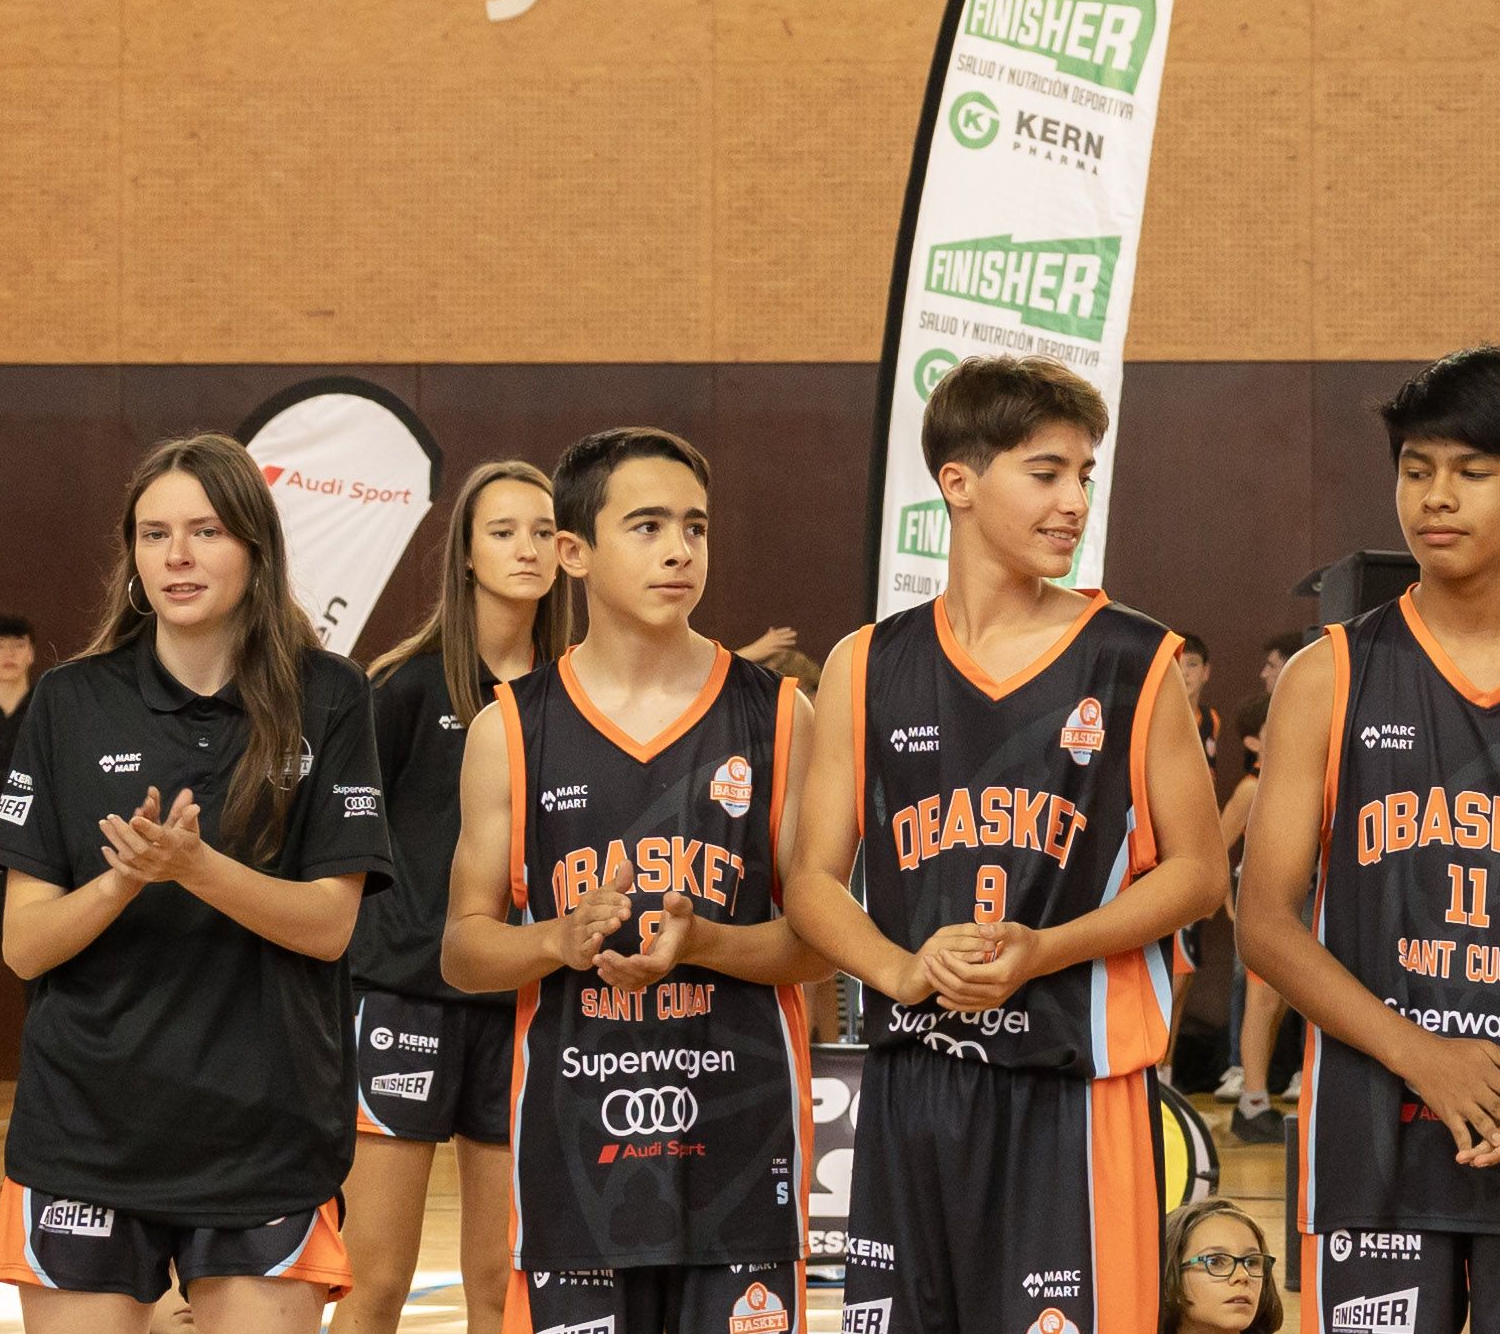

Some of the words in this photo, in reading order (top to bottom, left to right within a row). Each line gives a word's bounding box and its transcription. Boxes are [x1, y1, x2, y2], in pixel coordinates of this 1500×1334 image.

[957, 53, 997, 79] SALUD
[998, 64, 1006, 82] Y
[1071, 86, 1134, 120] DEPORTIVA
[1015, 109, 1104, 160] KERN
[1012, 141, 1099, 176] PHARMA
[930, 250, 1102, 319] FINISHER
[919, 310, 959, 336] SALUD
[961, 320, 970, 338] Y
[1036, 337, 1100, 368] DEPORTIVA
[286, 471, 344, 496] Audi
[349, 482, 412, 505] Sport
[894, 573, 932, 596] SALUD
[908, 725, 940, 738] MARC
[1381, 724, 1417, 737] MARC
[908, 740, 940, 753] MART
[1380, 738, 1415, 750] MART
[115, 753, 142, 762] MARC
[115, 763, 141, 773] MART
[556, 784, 589, 798] MARC
[557, 798, 588, 811] MART
[891, 785, 1087, 871] QBASKET
[974, 864, 1007, 926] 9
[1445, 863, 1490, 928] 11
[1399, 937, 1457, 979] SANT
[581, 985, 648, 1022] SANT
[400, 1032, 439, 1048] KERN
[561, 1046, 736, 1083] Superwagen
[373, 1077, 428, 1095] FINISHER
[622, 1141, 662, 1159] Audi
[777, 1181, 789, 1205] S
[846, 1237, 895, 1262] KERN
[1360, 1232, 1422, 1252] KERN
[1359, 1250, 1422, 1261] PHARMA
[1044, 1270, 1081, 1282] MARC
[1044, 1285, 1081, 1298] MART
[1334, 1298, 1410, 1327] FINISHER
